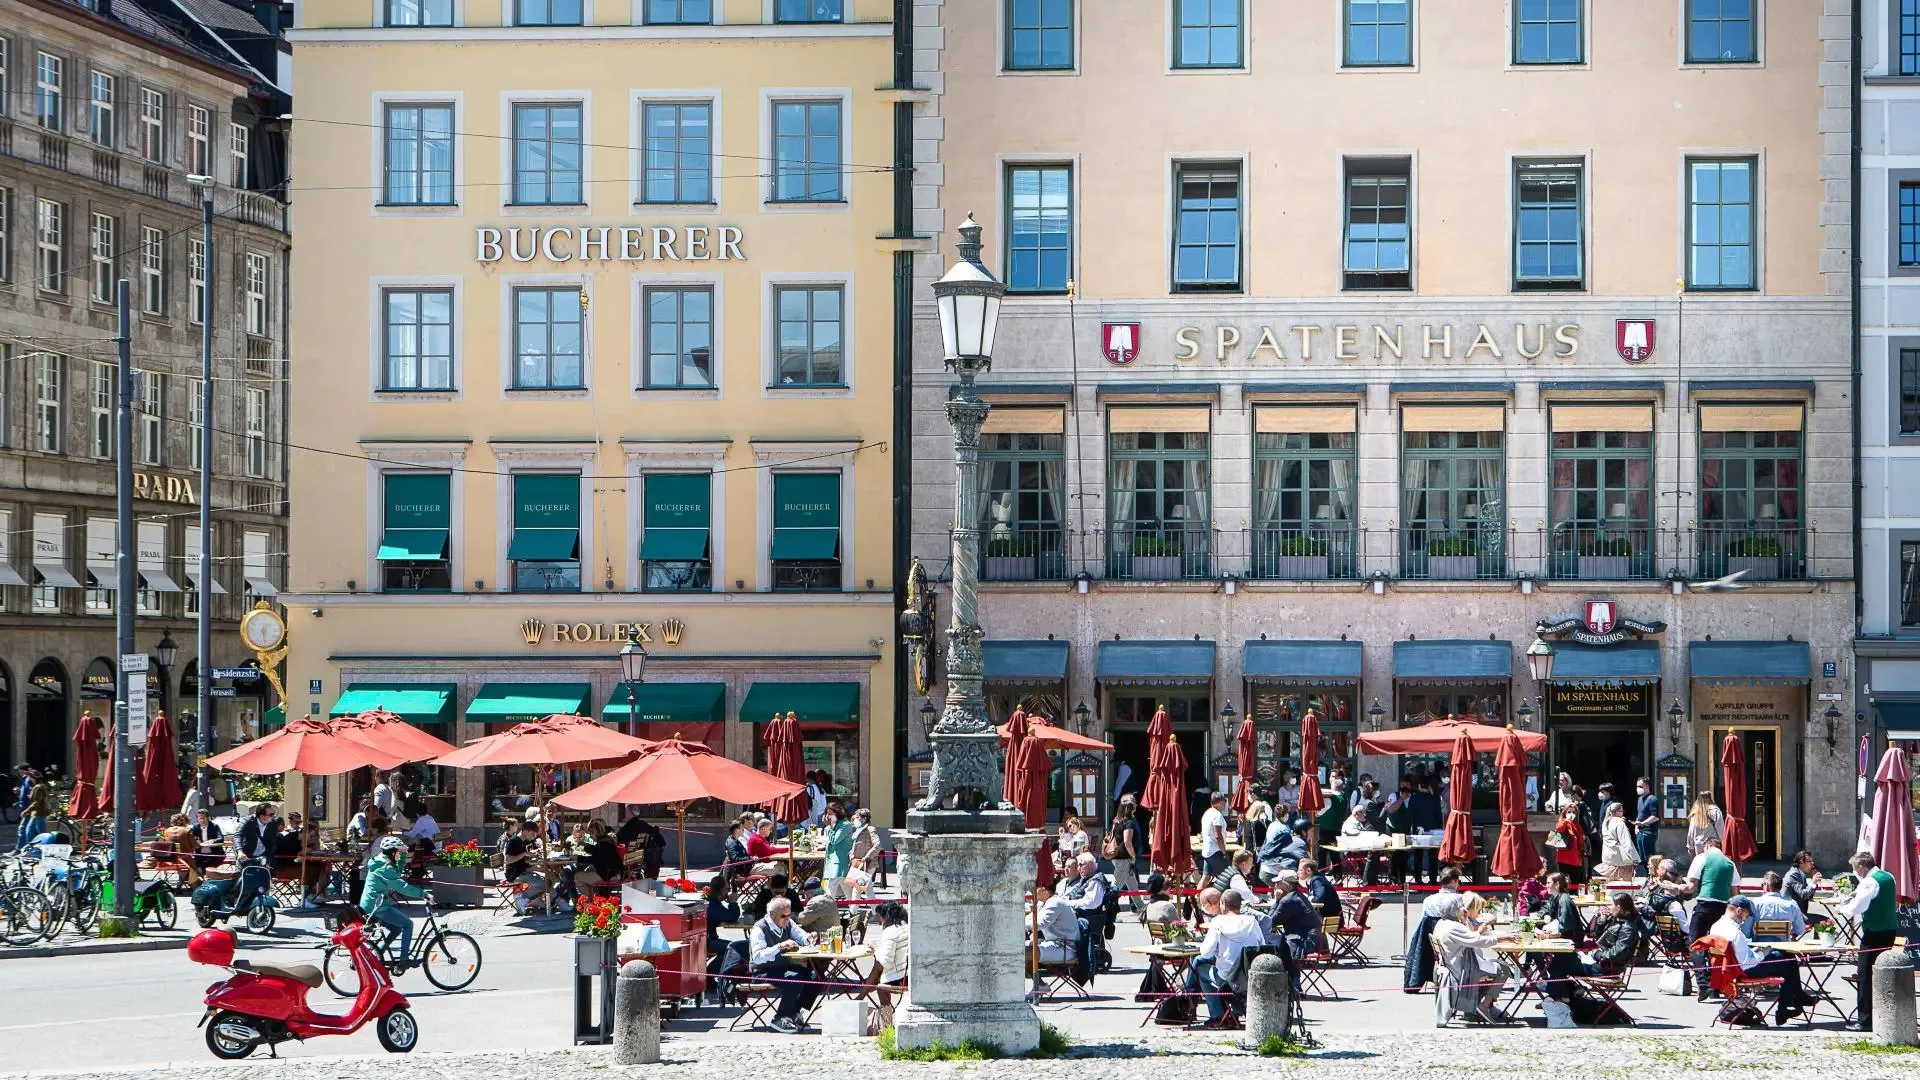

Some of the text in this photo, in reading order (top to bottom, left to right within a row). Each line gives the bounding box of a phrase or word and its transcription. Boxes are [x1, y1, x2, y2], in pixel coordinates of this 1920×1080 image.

[475, 226, 748, 263] BUCHERER
[1175, 323, 1581, 361] SPATENHAUS
[133, 472, 197, 505] RADA
[395, 503, 441, 512] BUCHERER
[524, 503, 571, 512] BUCHERER
[655, 503, 701, 512] BUCHERER
[784, 503, 831, 511] BUCHERER
[551, 622, 655, 643] ROLEX
[1575, 632, 1624, 643] SPATENHAUS
[1825, 663, 1835, 671] 12
[213, 668, 257, 679] Residenzstr.
[88, 676, 110, 684] PRADA
[312, 680, 320, 688] 11
[1557, 692, 1640, 702] IM SPATENHAUS
[1567, 704, 1602, 712] Gemeinsam
[1615, 704, 1629, 712] 1982
[1715, 702, 1775, 710] KUFFLER GRUPPE
[1731, 711, 1790, 721] RECHTSANWÄLTE
